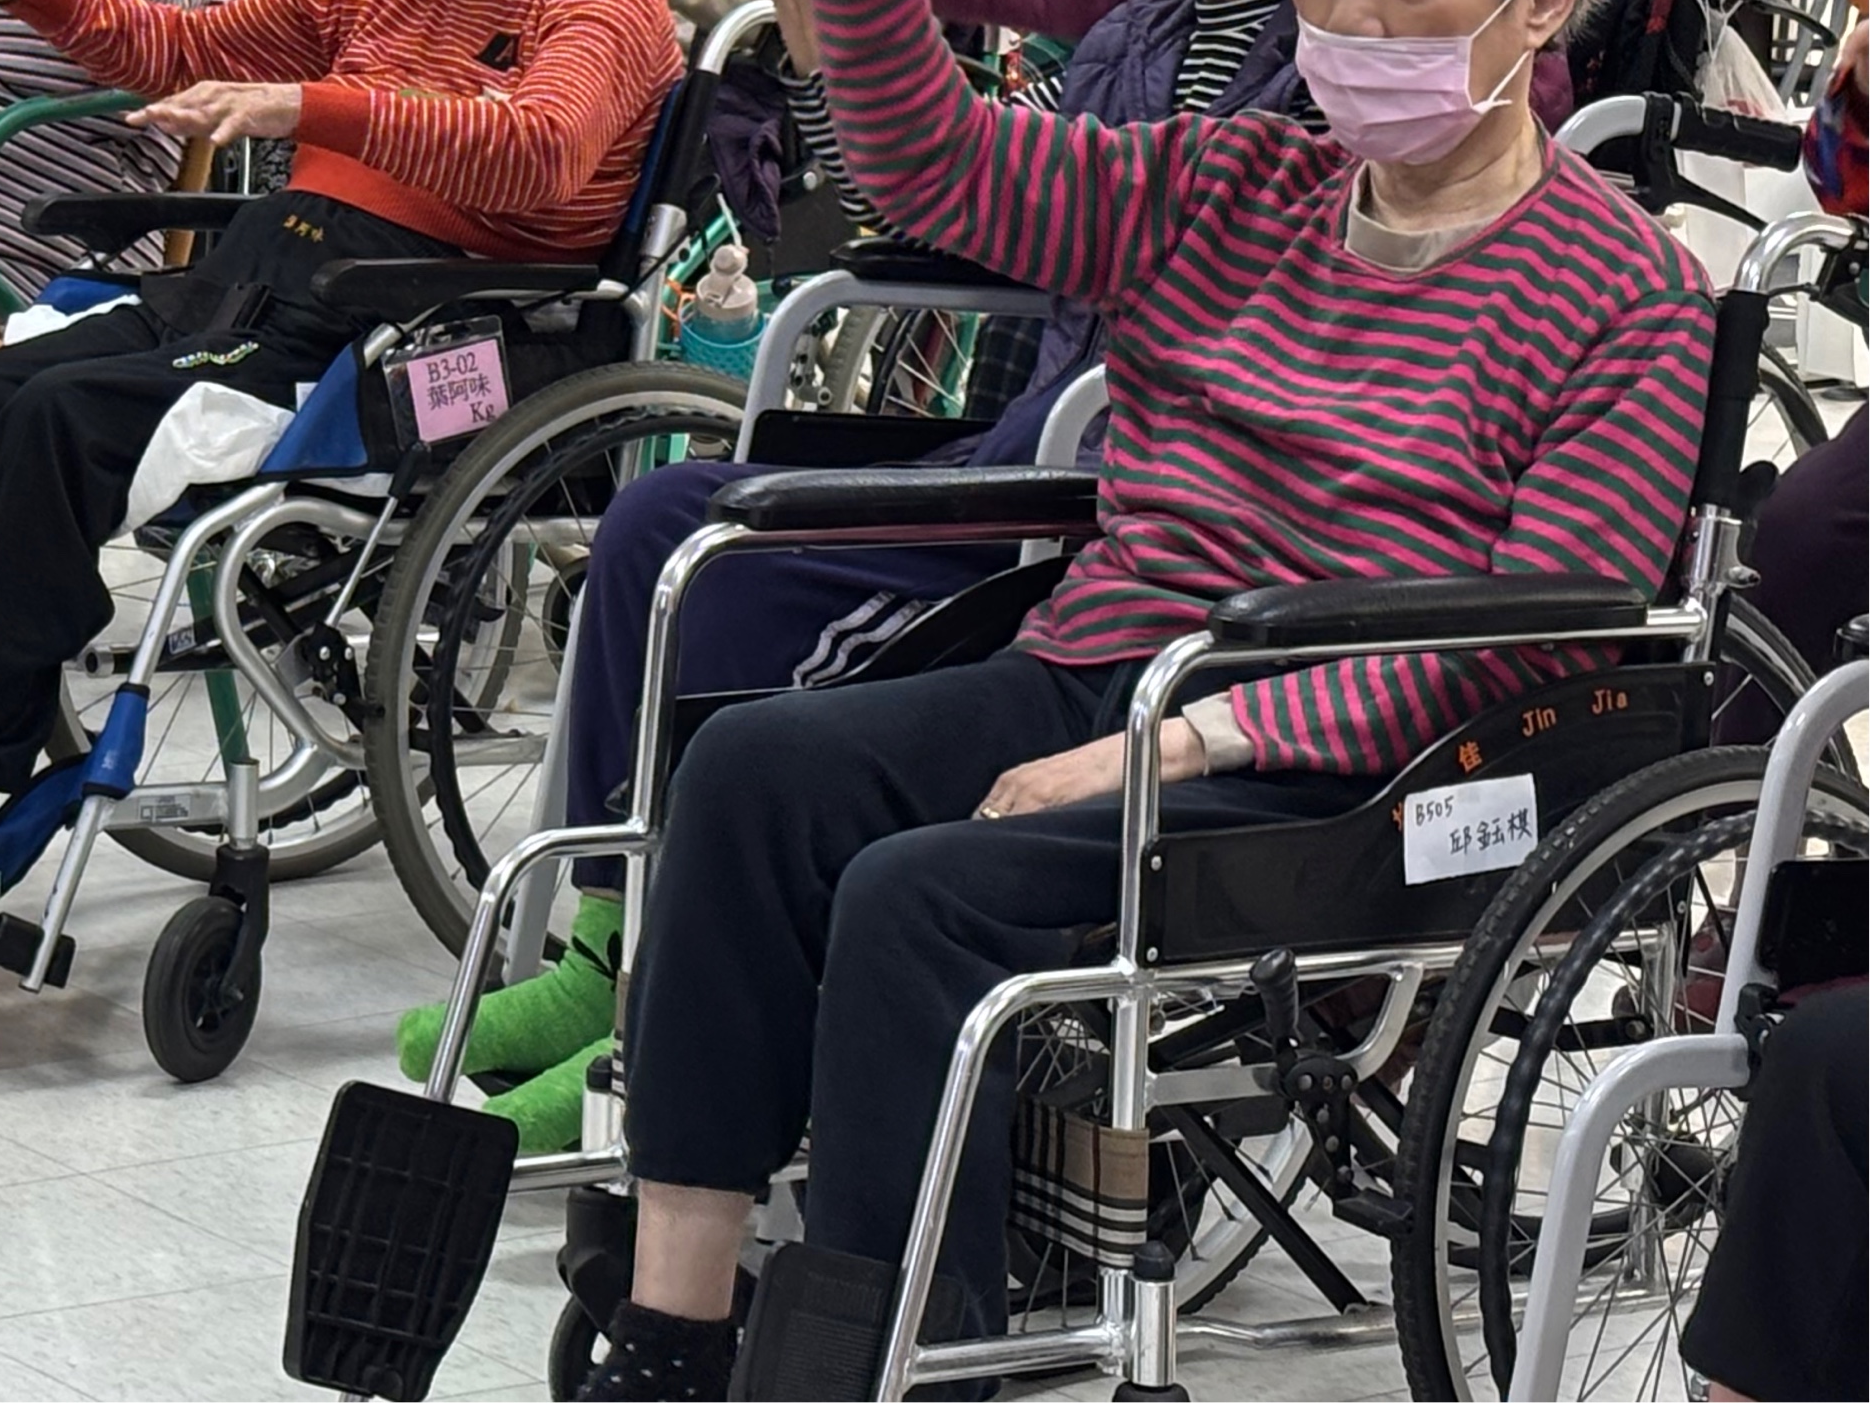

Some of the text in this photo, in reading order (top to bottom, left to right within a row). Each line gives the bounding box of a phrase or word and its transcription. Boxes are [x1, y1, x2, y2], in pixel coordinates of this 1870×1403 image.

[426, 351, 479, 384] B3-02
[470, 401, 496, 424] Kg
[1522, 689, 1628, 737] Jin Jia
[1458, 740, 1483, 774] 佳
[1415, 795, 1455, 827] B505
